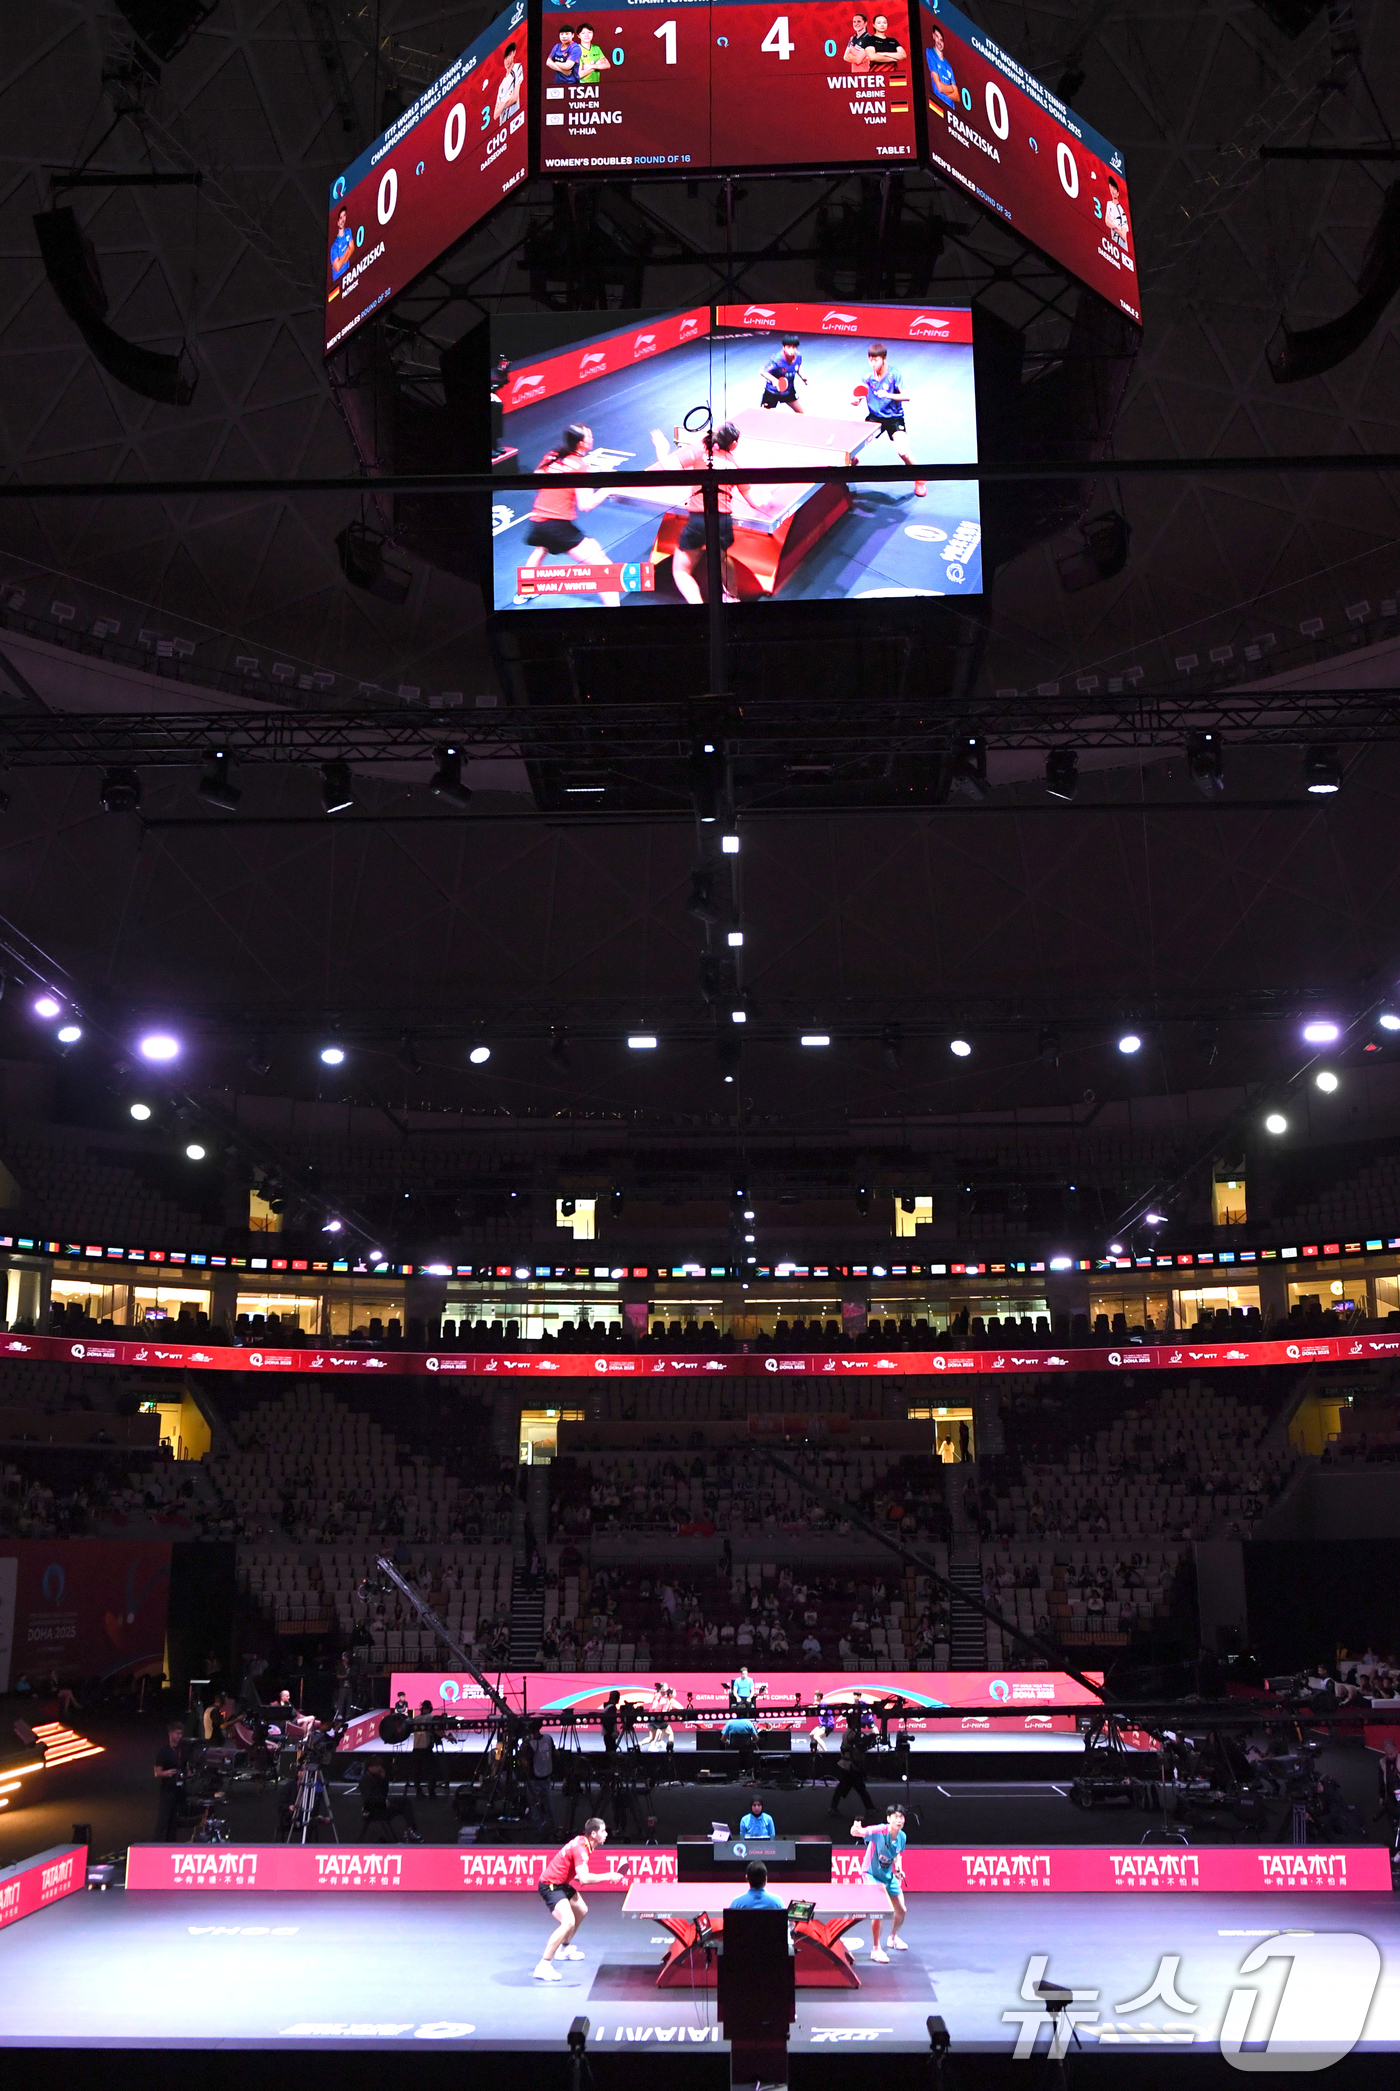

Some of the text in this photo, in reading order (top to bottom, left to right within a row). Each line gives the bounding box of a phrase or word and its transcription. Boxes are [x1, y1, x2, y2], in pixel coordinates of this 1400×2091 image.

[612, 16, 837, 66] 0 1 4 0
[827, 75, 885, 89] WINTER
[986, 38, 1067, 115] ITTF WORLD TABLE TENNIS
[568, 86, 600, 98] TSAI
[856, 90, 885, 98] SABINE
[972, 37, 1082, 138] CHAMPIONSHIPS FINALS DOHA 2025
[384, 59, 462, 141] ITTF WORLD TABLE TENNIS
[569, 101, 600, 109] YUN-EN
[850, 101, 886, 115] WAN
[961, 88, 971, 110] 0
[371, 55, 477, 165] CHAMPIONSHIPS FINALS DOHA 2025
[481, 106, 490, 130] 3
[568, 111, 622, 125] HUANG
[864, 116, 886, 124] YUAN
[985, 81, 1009, 140] 0
[444, 103, 466, 161] 0
[486, 128, 507, 154] CHO
[569, 127, 597, 135] YI-HUA
[947, 111, 1000, 163] FRANZISKA
[949, 127, 969, 148] PATRICK
[480, 143, 507, 171] DAESEONG
[591, 157, 632, 165] DOUBLES
[634, 156, 665, 164] ROUND
[876, 146, 911, 155] TABLE 1
[502, 168, 525, 192] TABLE 2
[1057, 142, 1079, 198] 0
[377, 169, 398, 225] 0
[1093, 197, 1102, 219] 3
[356, 226, 364, 247] 0
[1101, 237, 1120, 259] CHO
[342, 242, 385, 289] FRANZISKA
[342, 280, 358, 299] PATRICK
[744, 318, 775, 326] LI-NING
[822, 323, 857, 332] LI-NING
[909, 329, 949, 337] LI-NING
[512, 386, 545, 404] LI-NING
[537, 582, 597, 591] WAN / WINTER
[28, 1626, 76, 1641] DOHA 2025
